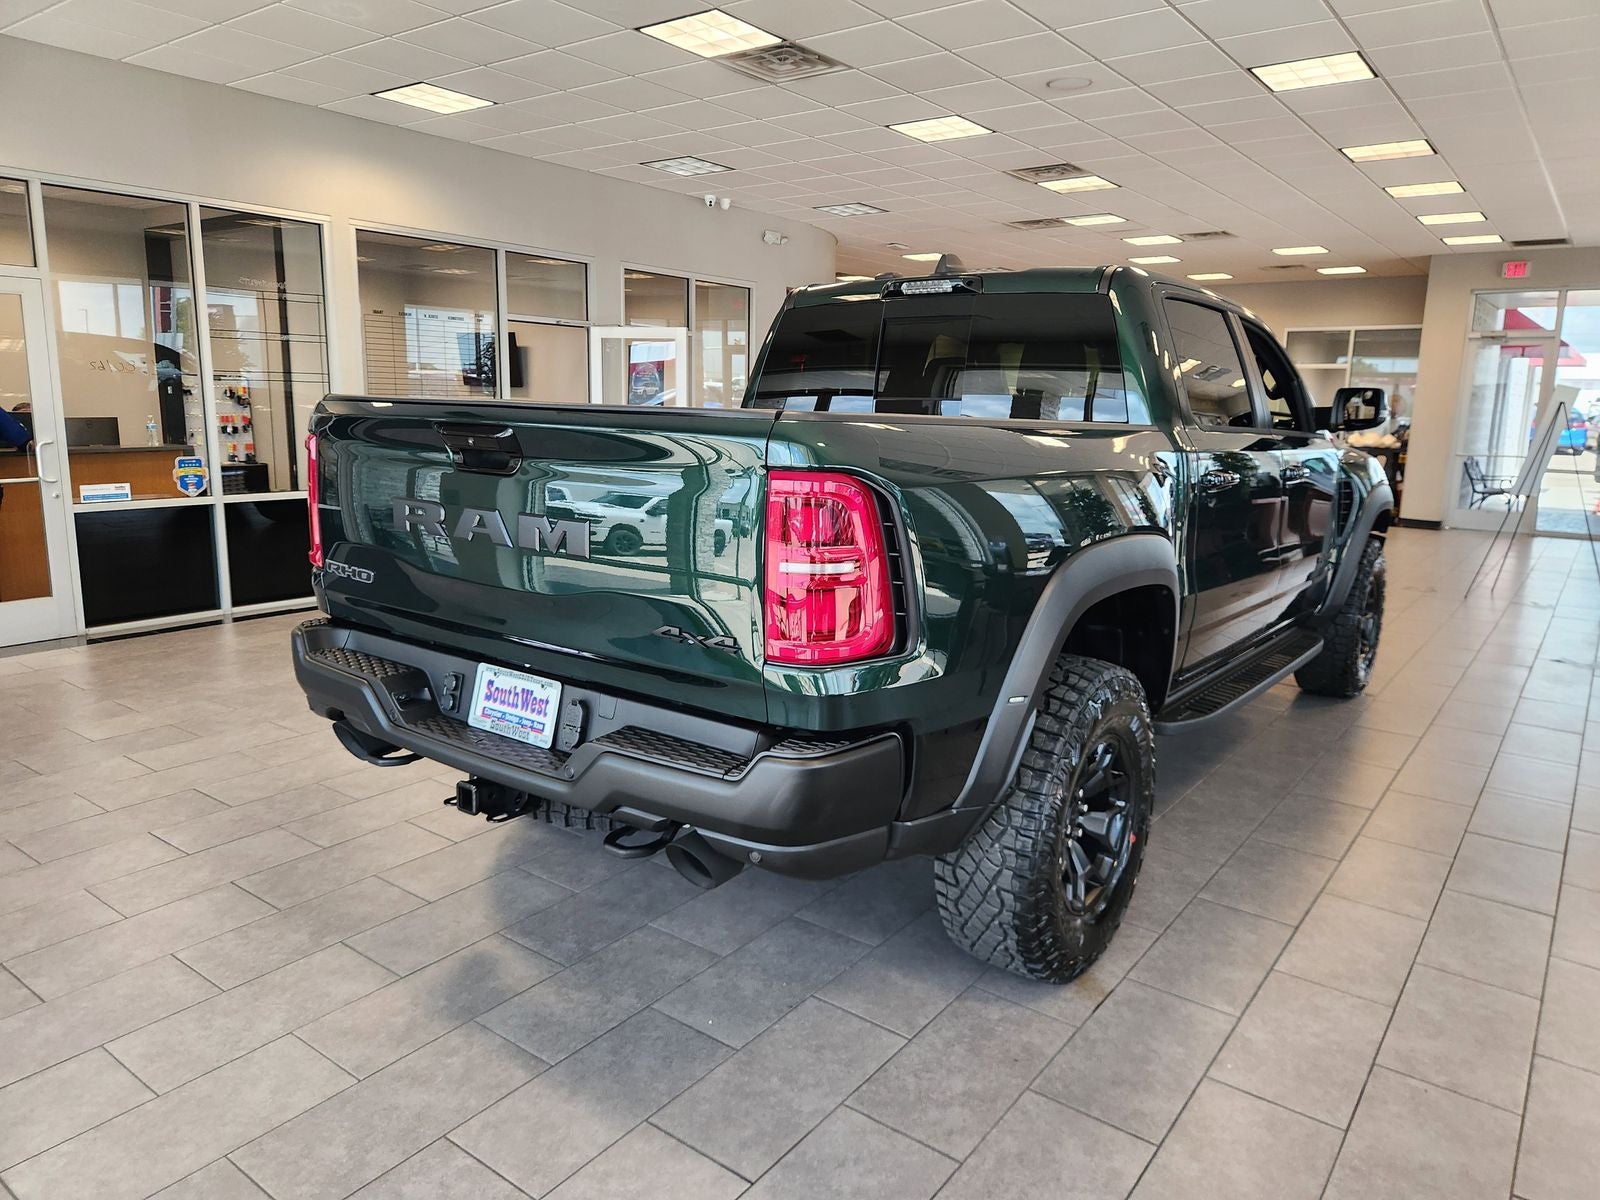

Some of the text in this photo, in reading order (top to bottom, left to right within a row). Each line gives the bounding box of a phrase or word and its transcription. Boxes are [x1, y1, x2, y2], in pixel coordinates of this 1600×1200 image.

[392, 497, 591, 560] RAM
[325, 559, 375, 584] RHO
[484, 679, 550, 718] SouthWest
